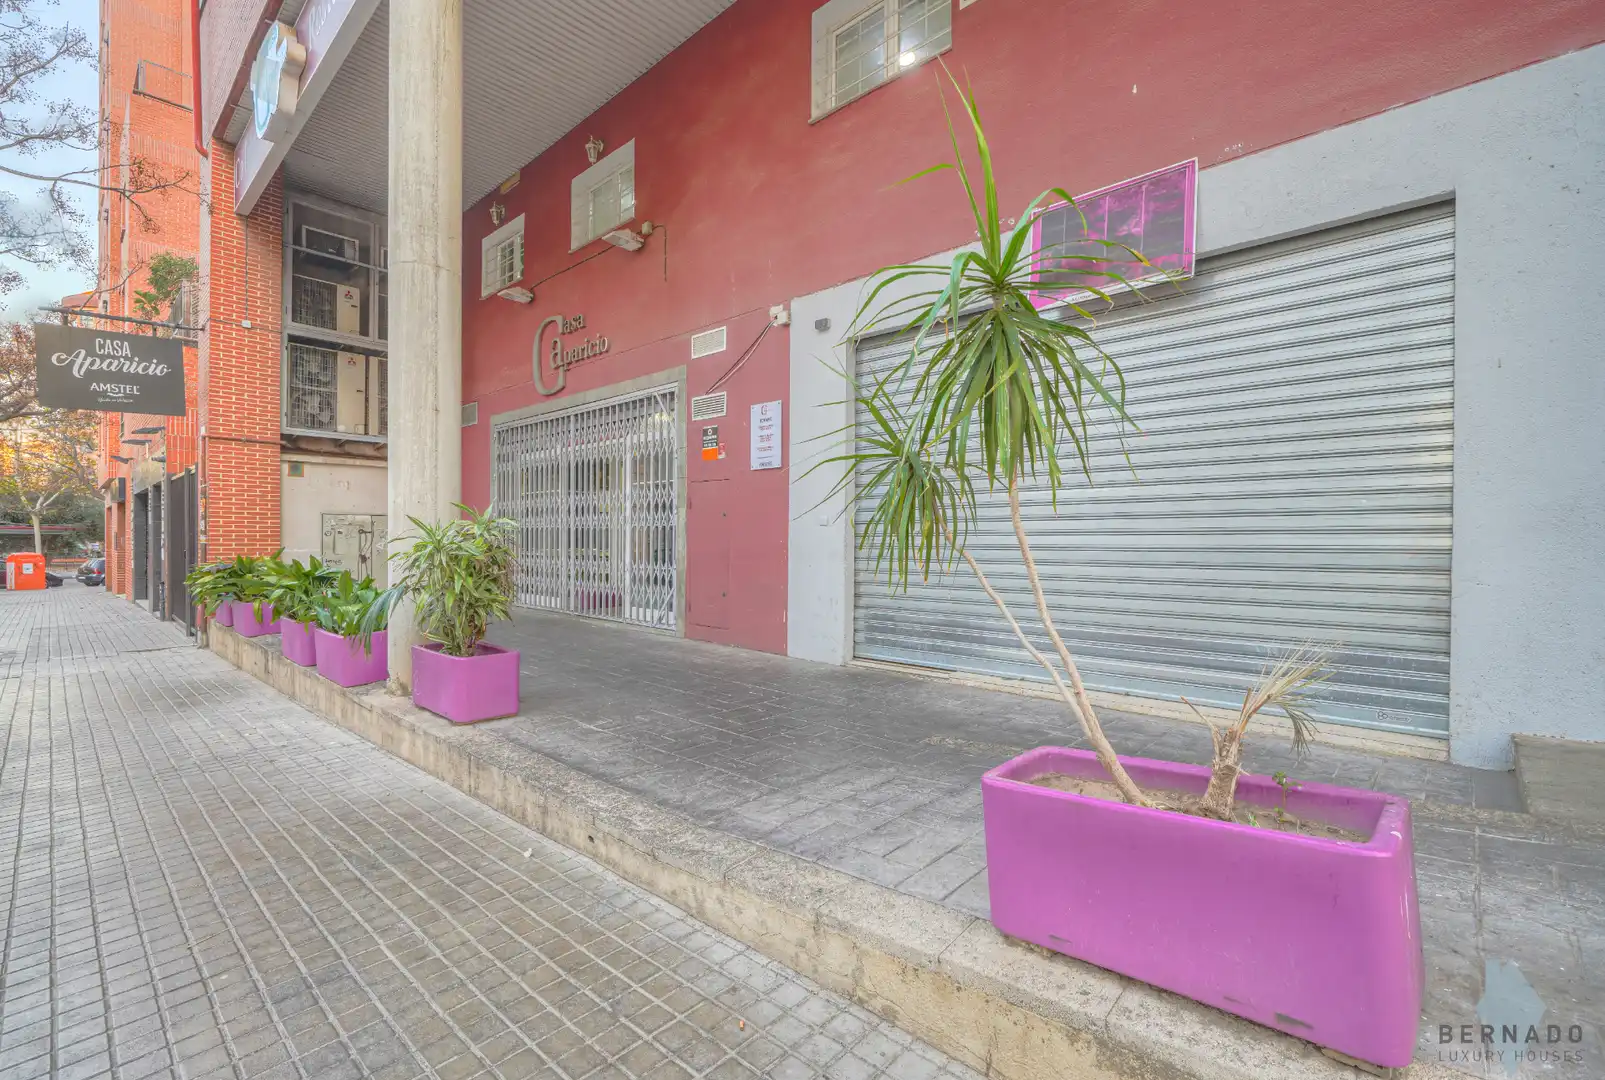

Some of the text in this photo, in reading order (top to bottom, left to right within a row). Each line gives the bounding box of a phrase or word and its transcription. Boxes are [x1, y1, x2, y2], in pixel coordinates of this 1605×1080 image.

[95, 338, 132, 358] CASA
[51, 349, 172, 379] Aparicio
[90, 382, 141, 395] AMSTEL
